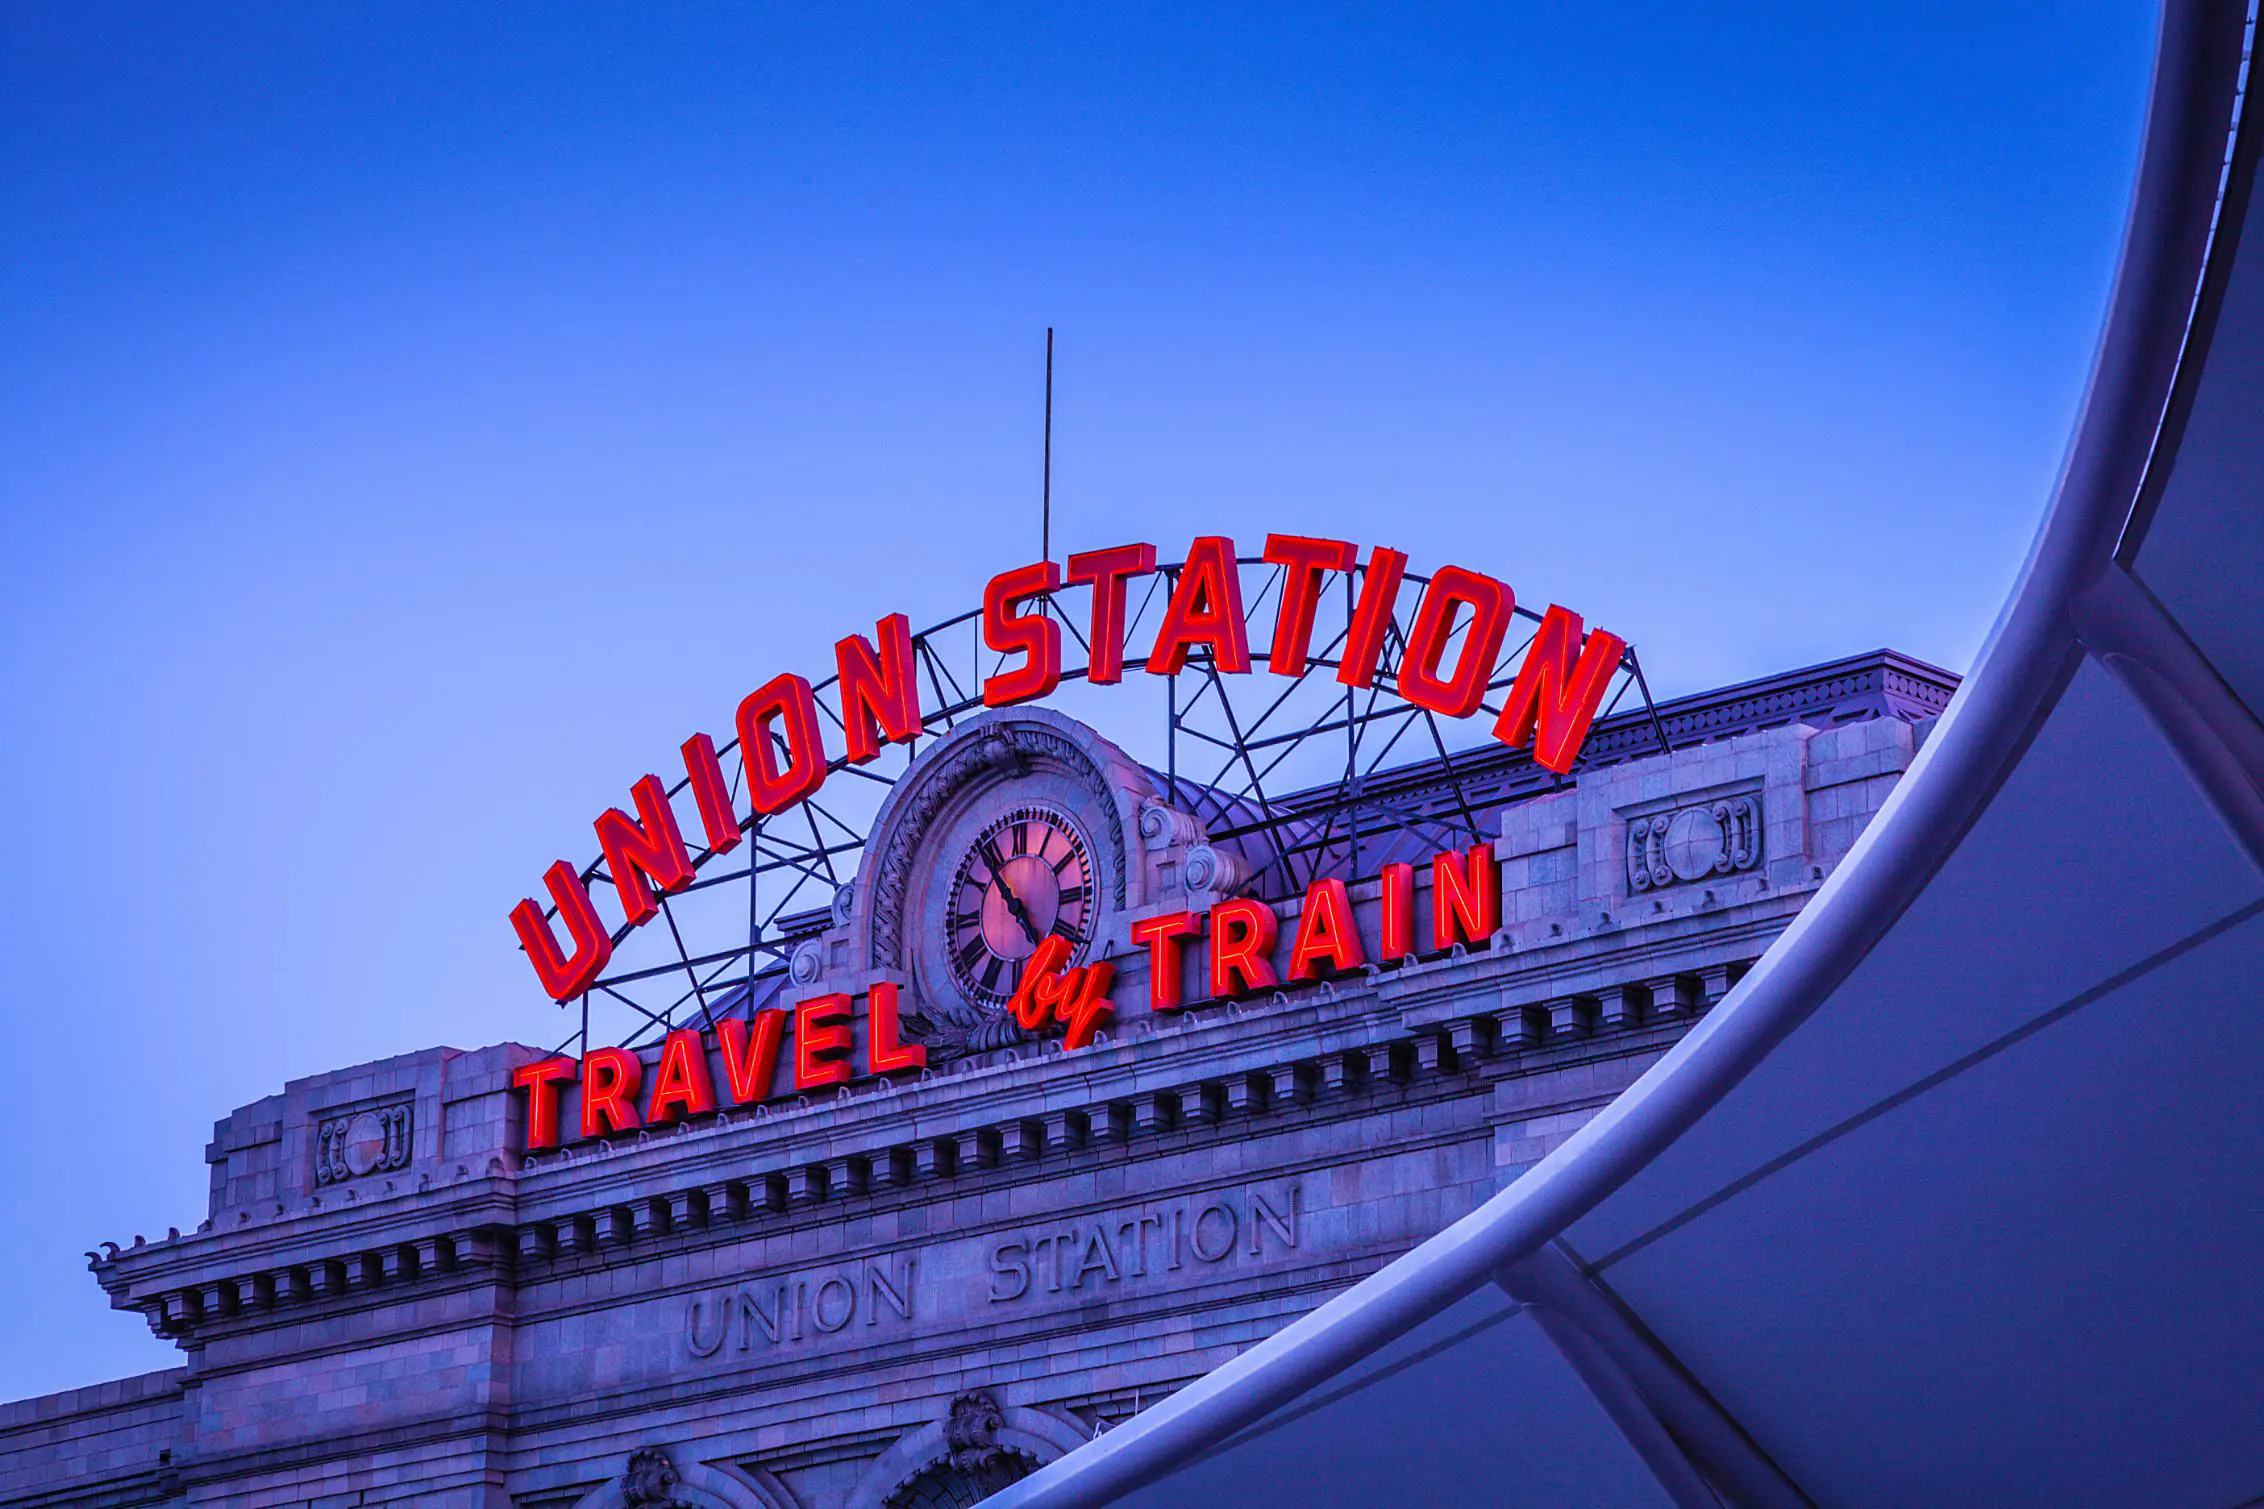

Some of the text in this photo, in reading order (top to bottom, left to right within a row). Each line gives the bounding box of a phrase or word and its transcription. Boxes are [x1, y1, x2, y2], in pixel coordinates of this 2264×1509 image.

[508, 533, 1627, 1001] UNION STATION
[513, 842, 1498, 1149] TRAVEL by TRAIN
[684, 1185, 1301, 1358] UNION STATION
